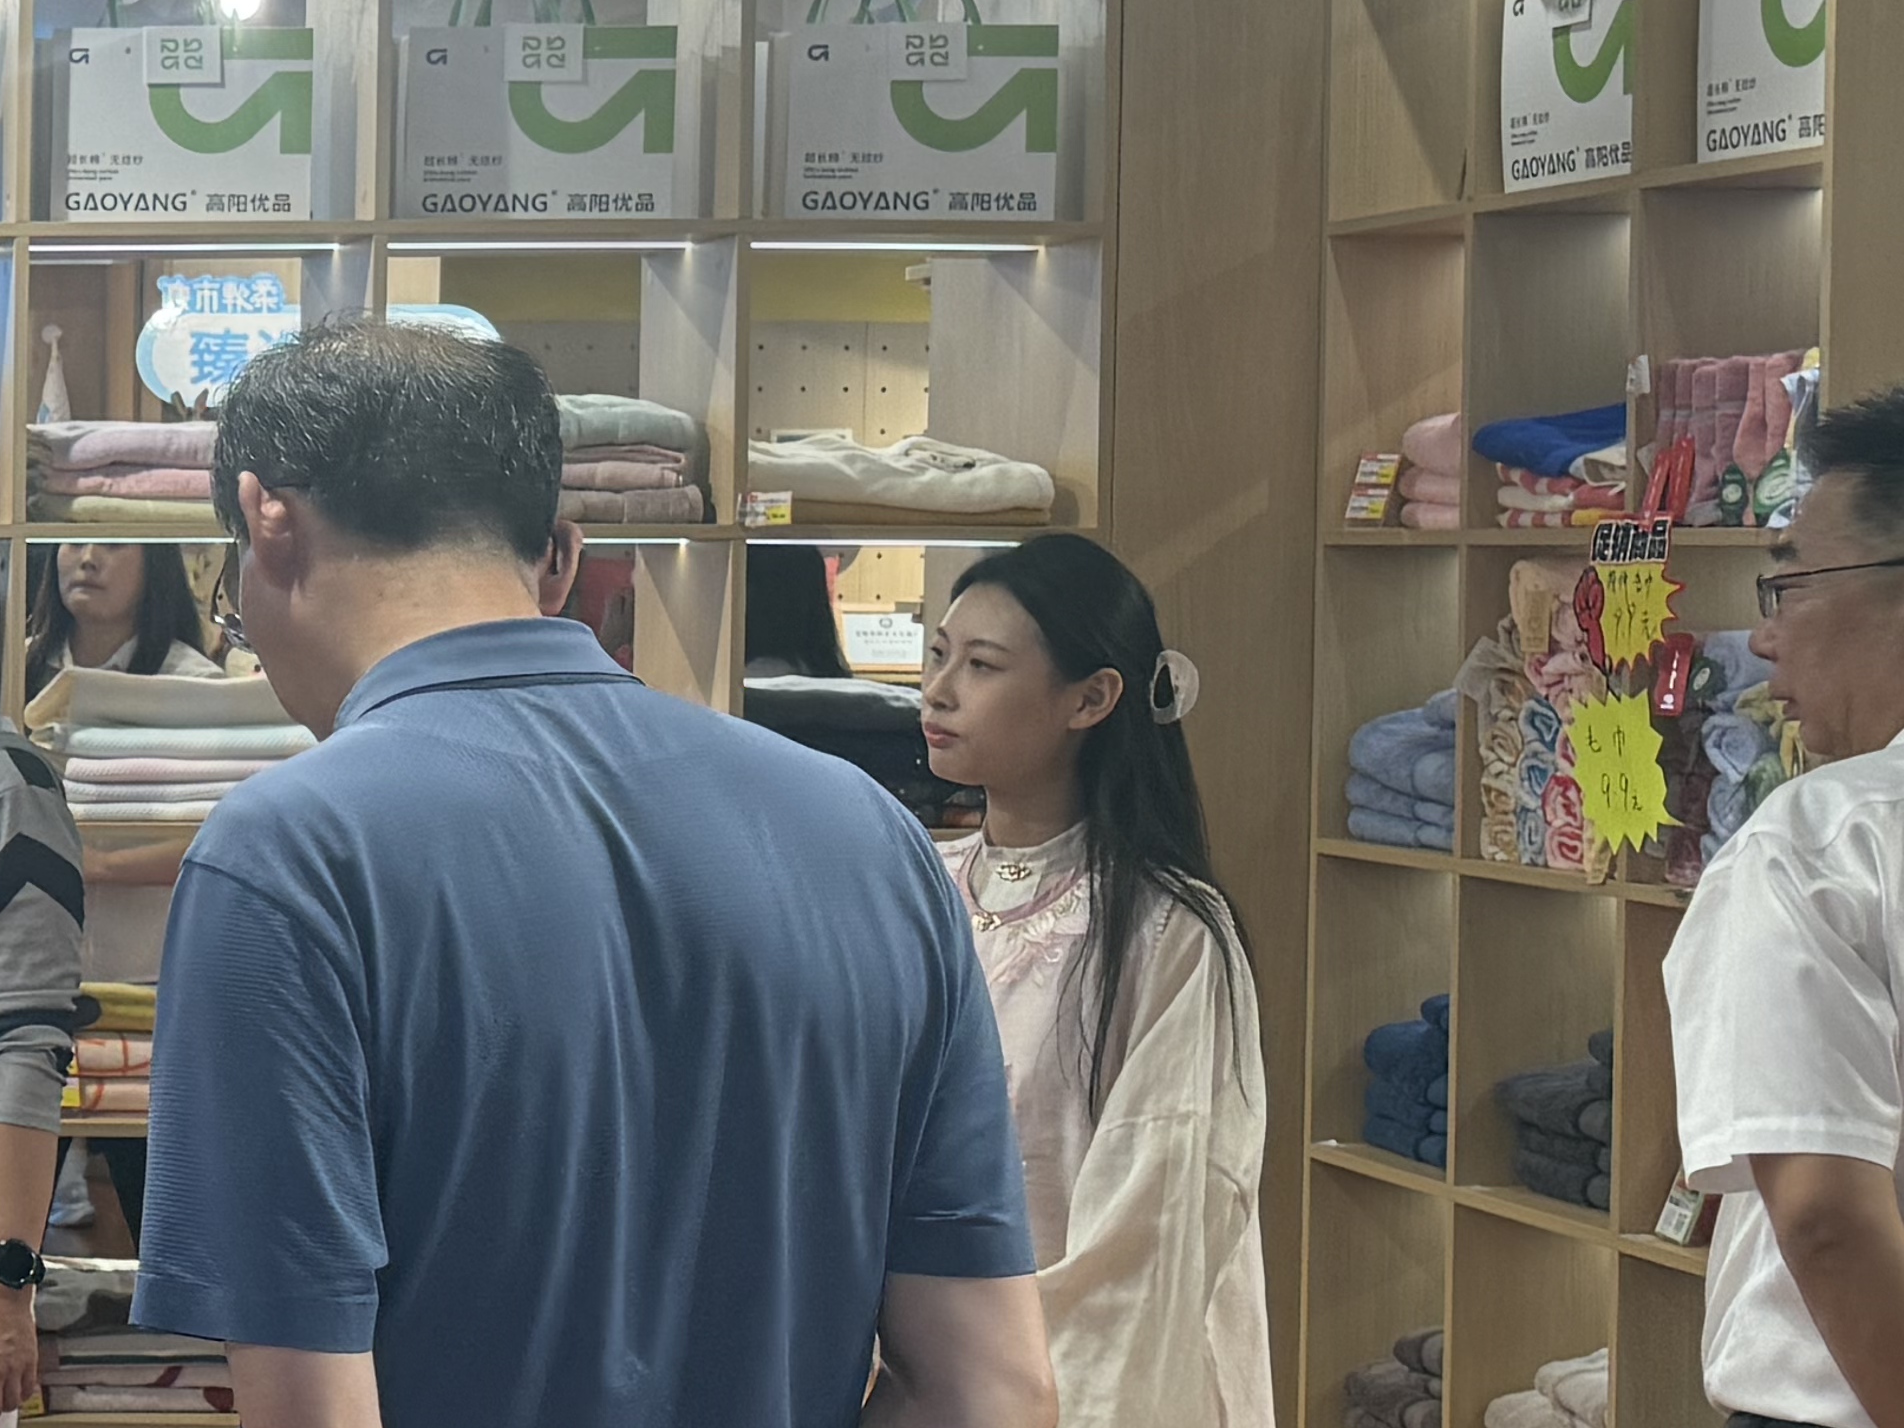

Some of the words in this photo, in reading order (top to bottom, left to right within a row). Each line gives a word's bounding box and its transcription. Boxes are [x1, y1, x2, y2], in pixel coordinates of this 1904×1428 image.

[1706, 118, 1787, 152] GAOYANG
[1511, 148, 1576, 181] GAOYANG
[64, 192, 188, 212] GAOYANG
[205, 192, 292, 213] 高阳优品
[421, 192, 548, 213] GAOYANG
[566, 192, 656, 213] 高阳优品
[801, 189, 930, 211] GAOYANG
[948, 190, 1038, 212] 高阳优品
